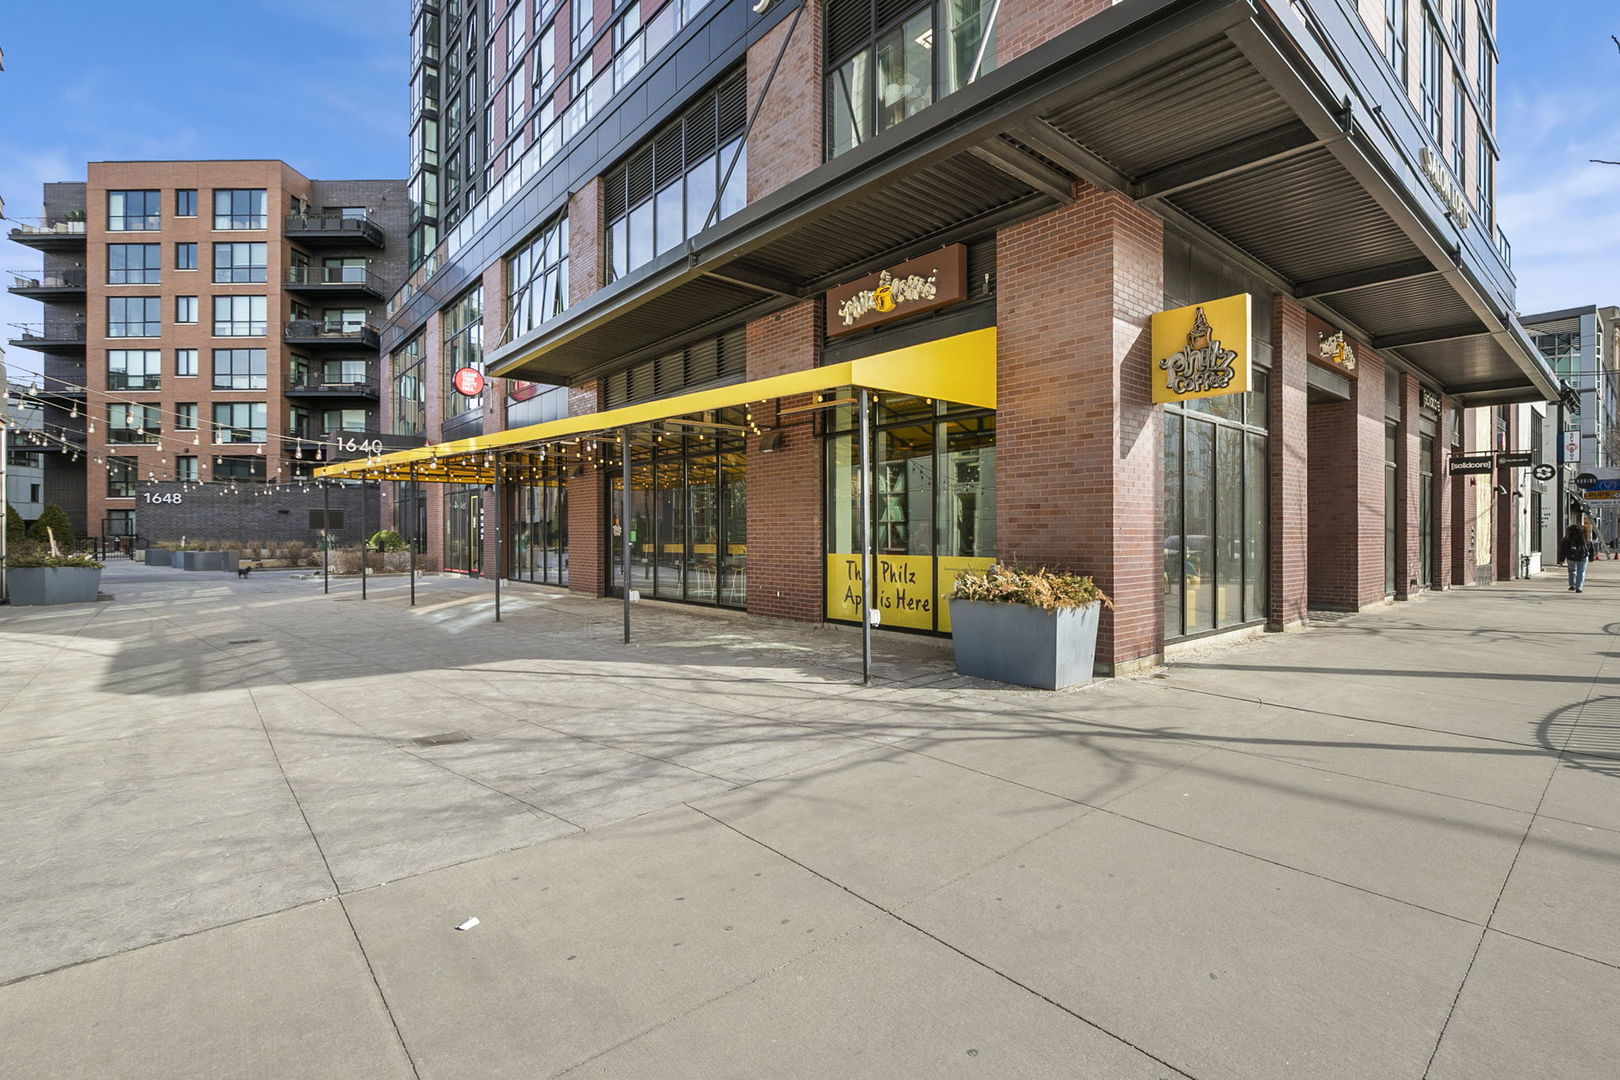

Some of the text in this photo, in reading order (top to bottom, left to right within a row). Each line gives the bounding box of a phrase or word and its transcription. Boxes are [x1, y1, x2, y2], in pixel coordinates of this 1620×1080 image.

[1159, 341, 1238, 389] Philz
[1173, 371, 1230, 394] Coffee
[336, 436, 383, 453] 1640
[143, 492, 182, 504] 1648
[846, 560, 917, 584] Th Philz
[844, 585, 931, 615] Ap is Here
